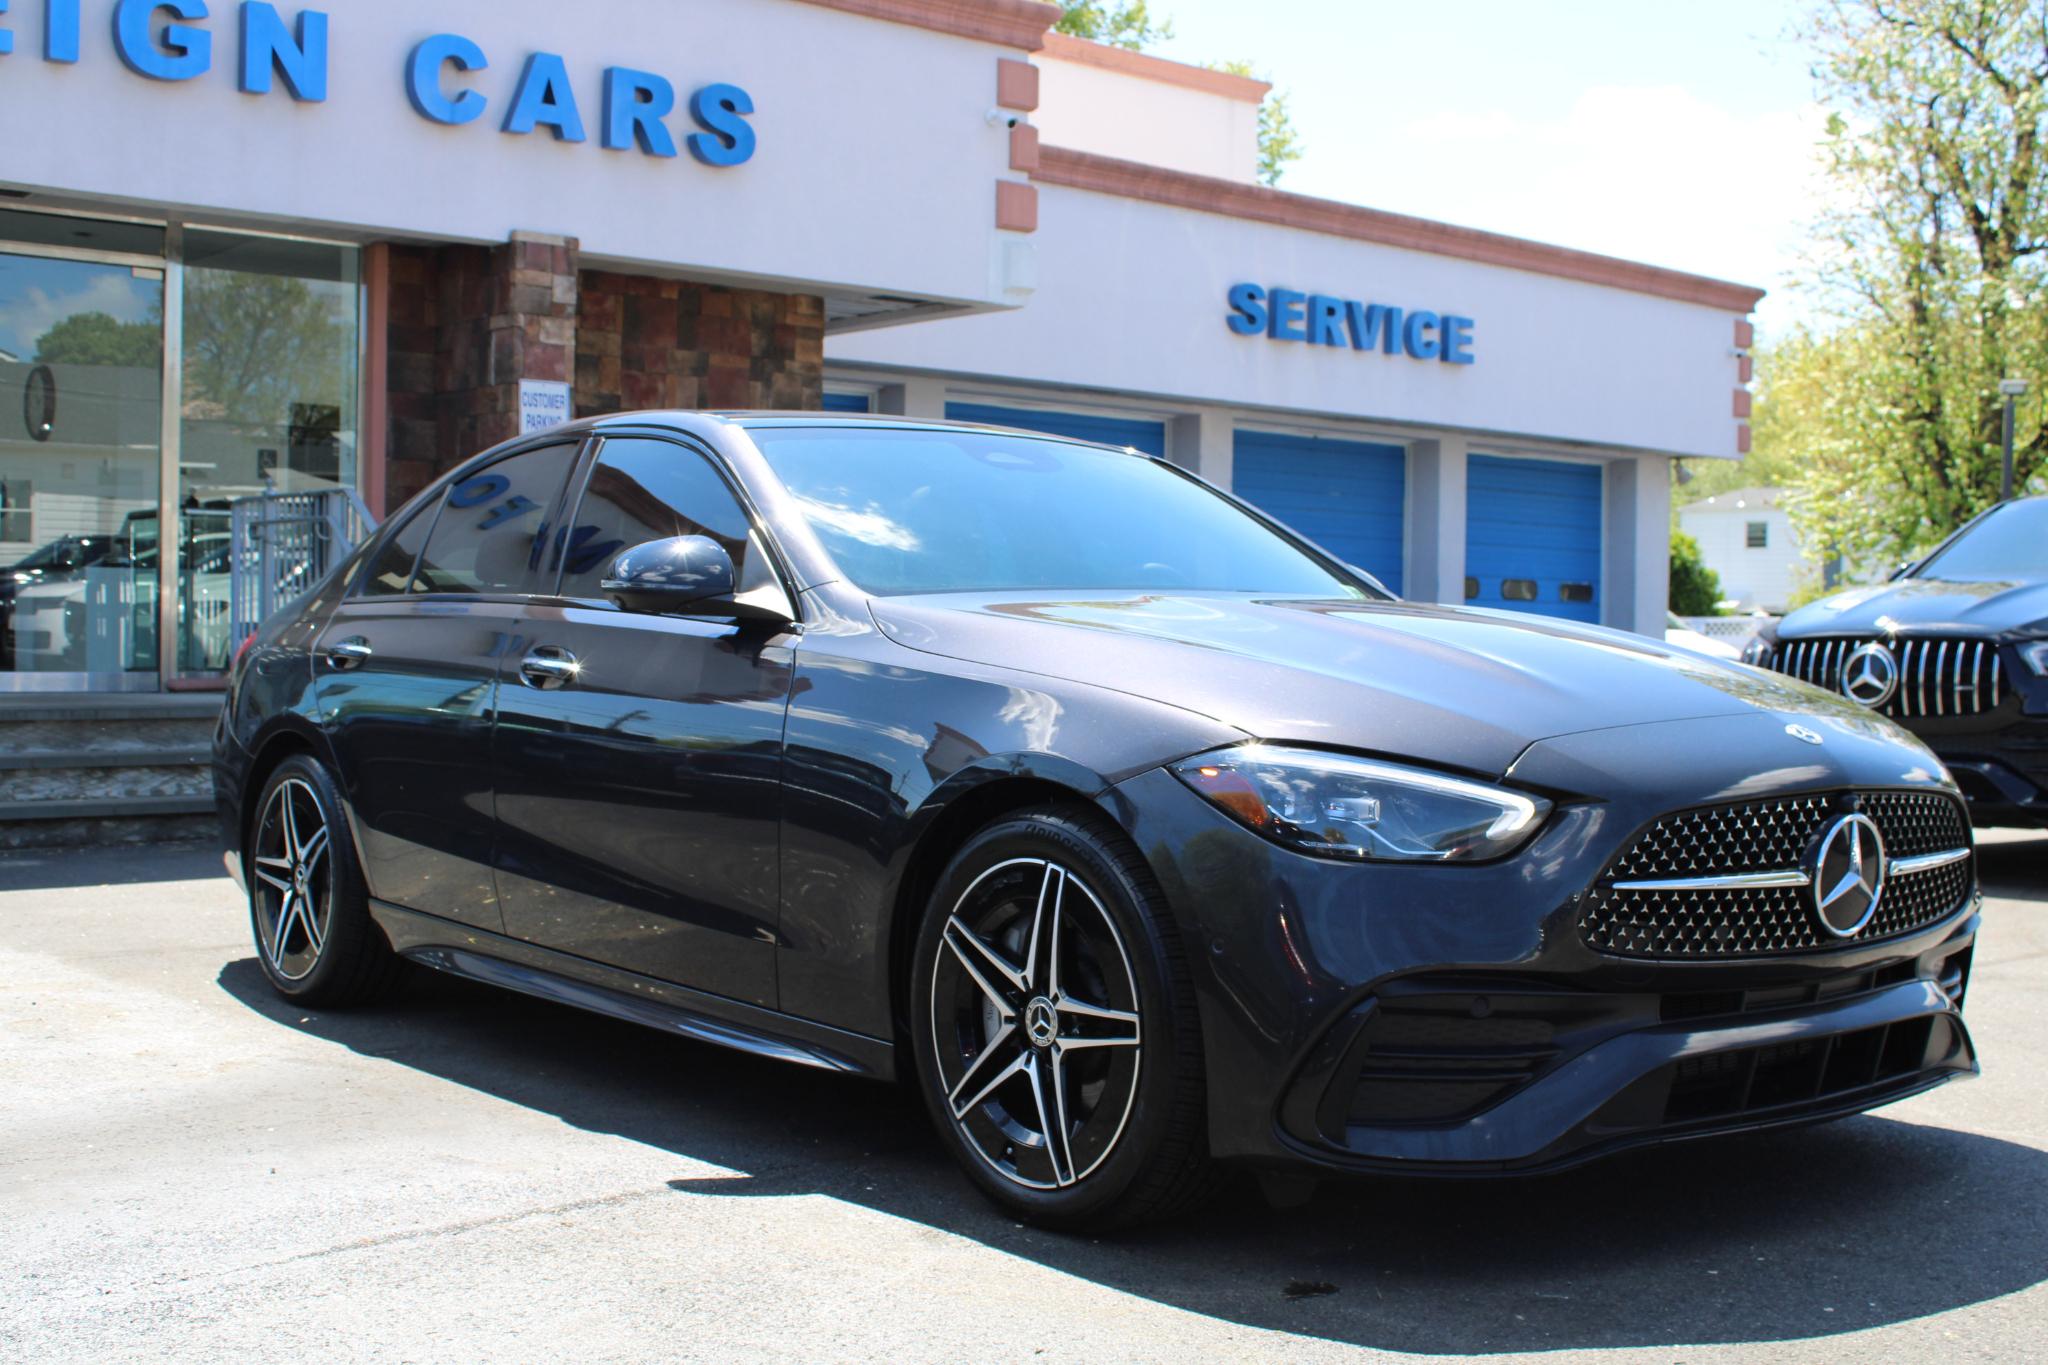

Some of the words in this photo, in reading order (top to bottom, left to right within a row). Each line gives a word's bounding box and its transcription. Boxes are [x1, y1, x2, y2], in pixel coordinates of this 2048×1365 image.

[0, 0, 327, 100] IGN
[405, 33, 756, 167] CARS
[1226, 283, 1474, 363] SERVICE
[522, 391, 565, 409] CUSTOMER
